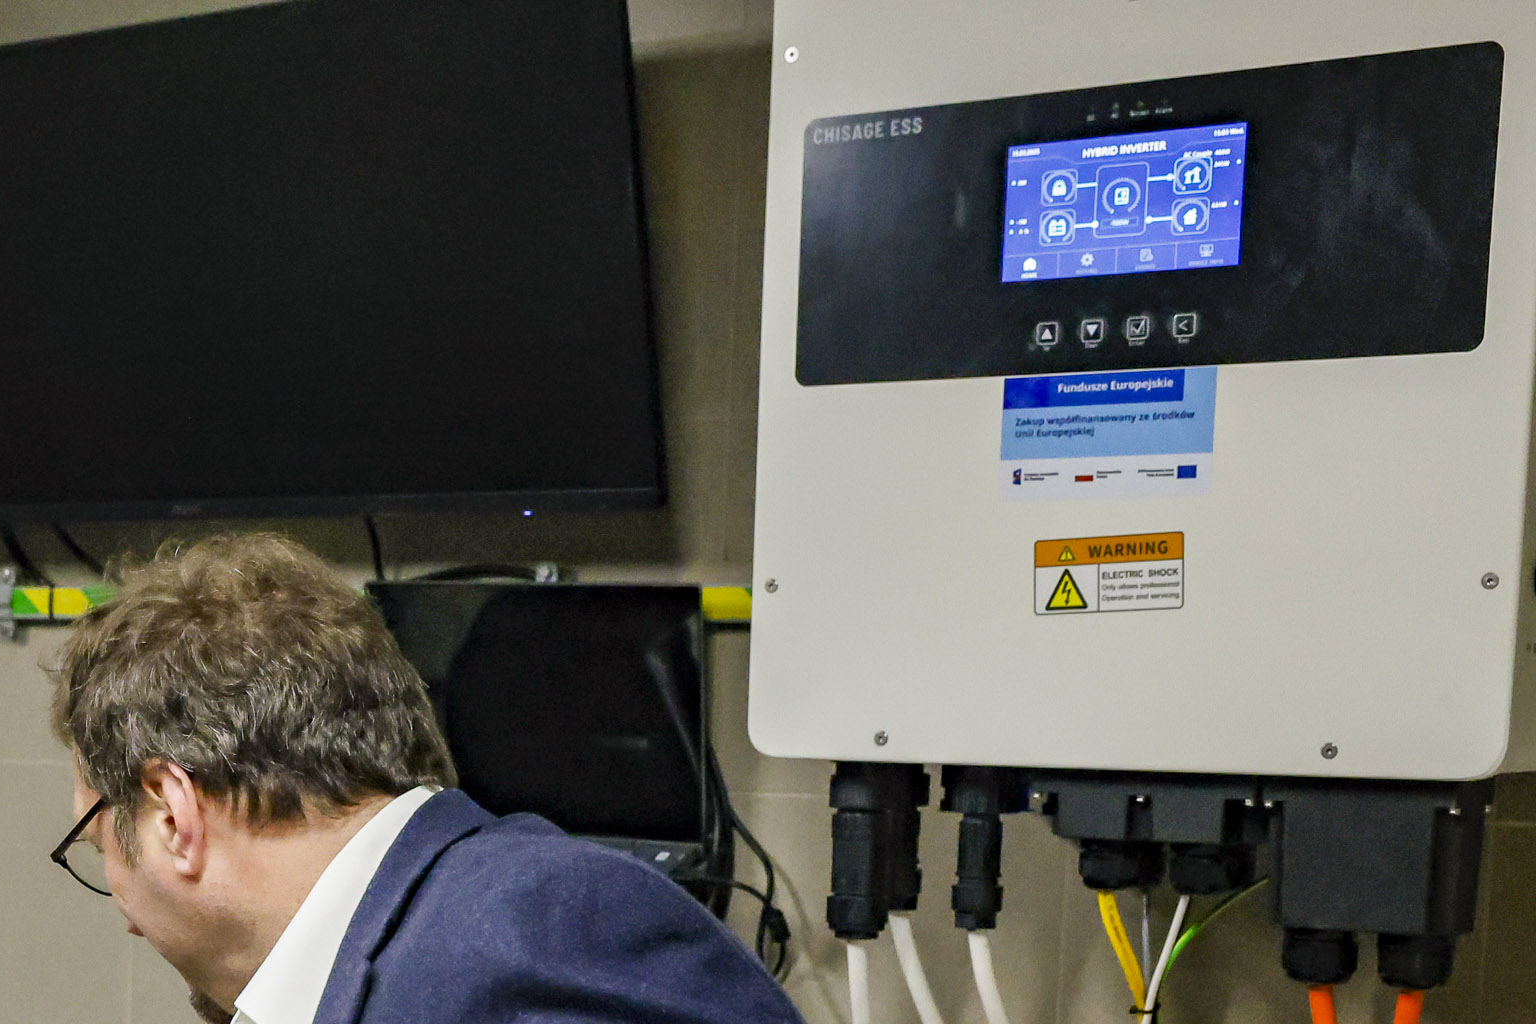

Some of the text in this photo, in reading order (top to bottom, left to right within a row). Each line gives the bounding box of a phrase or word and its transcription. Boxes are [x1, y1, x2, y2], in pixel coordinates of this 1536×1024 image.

[813, 116, 923, 145] CHISAGE ESS
[1082, 140, 1166, 158] HYBRID INVERTER
[1057, 377, 1175, 393] Fundusze Europejskie
[1015, 410, 1196, 428] Zakup współfinansowany ze środków
[1014, 427, 1095, 439] Unii Europejskiej
[1088, 540, 1168, 558] WARNING
[1102, 568, 1178, 580] ELECTRIC SHOCK
